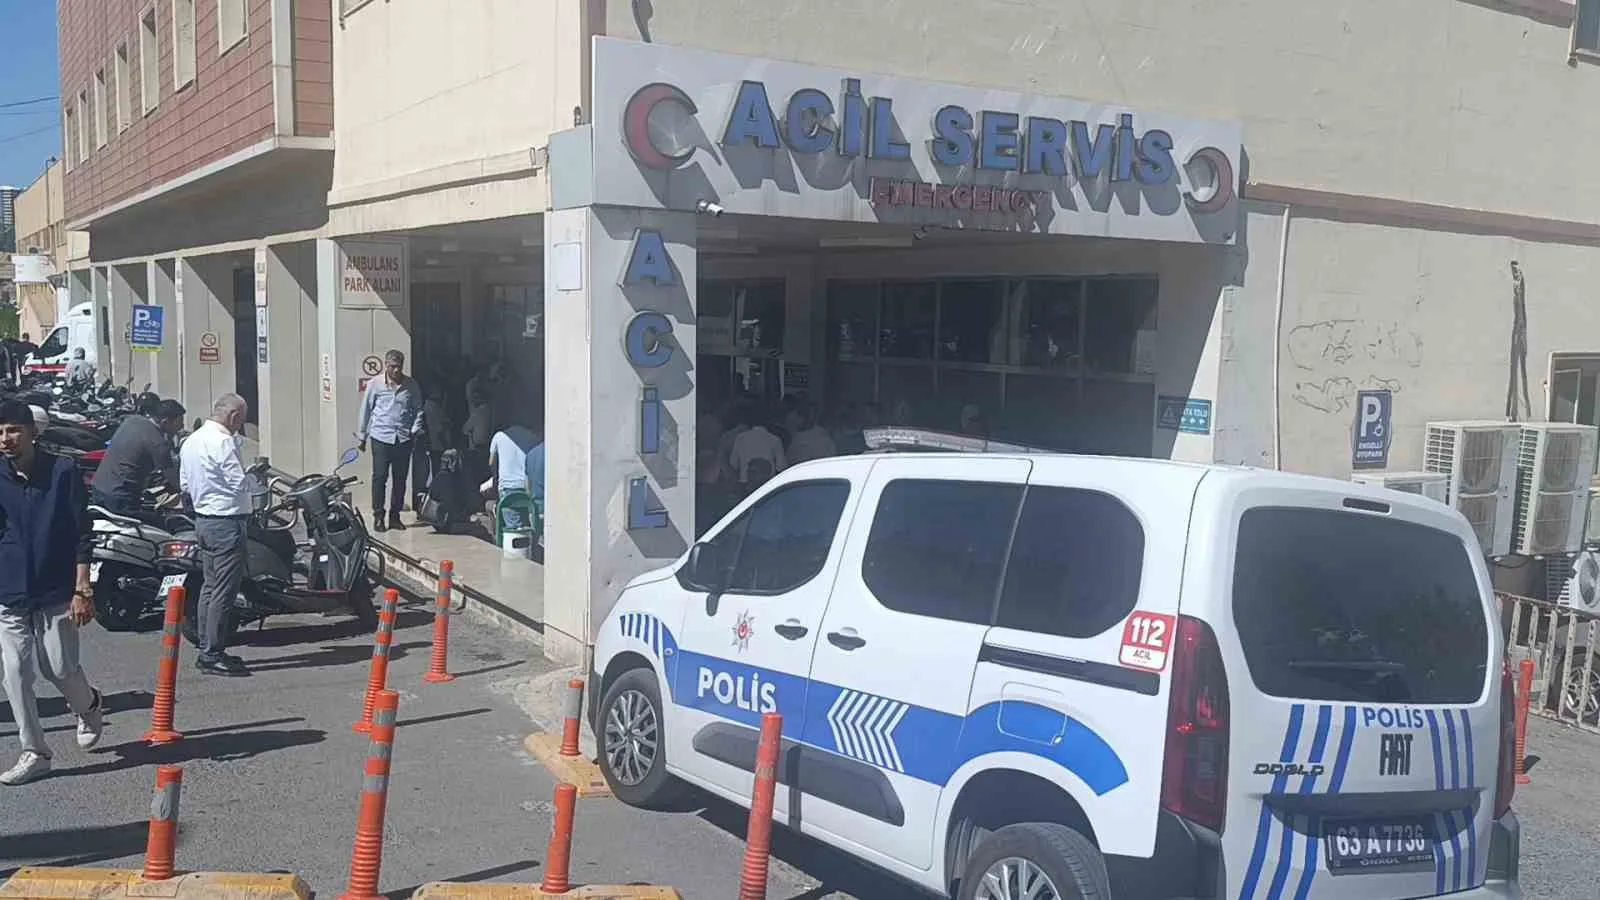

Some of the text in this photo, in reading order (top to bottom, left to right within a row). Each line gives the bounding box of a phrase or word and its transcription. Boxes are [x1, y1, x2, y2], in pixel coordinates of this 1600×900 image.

[717, 78, 1174, 186] ACİL SERVİS
[345, 255, 400, 271] AMBULANS
[344, 277, 370, 292] PARK
[134, 309, 150, 327] P
[618, 228, 676, 528] ACİL
[1361, 396, 1381, 437] P
[1131, 616, 1166, 647] 112
[697, 666, 777, 714] POLİS
[1363, 706, 1424, 728] POLİS
[1379, 733, 1413, 776] FIAT
[1336, 825, 1425, 856] 63 A 7736
